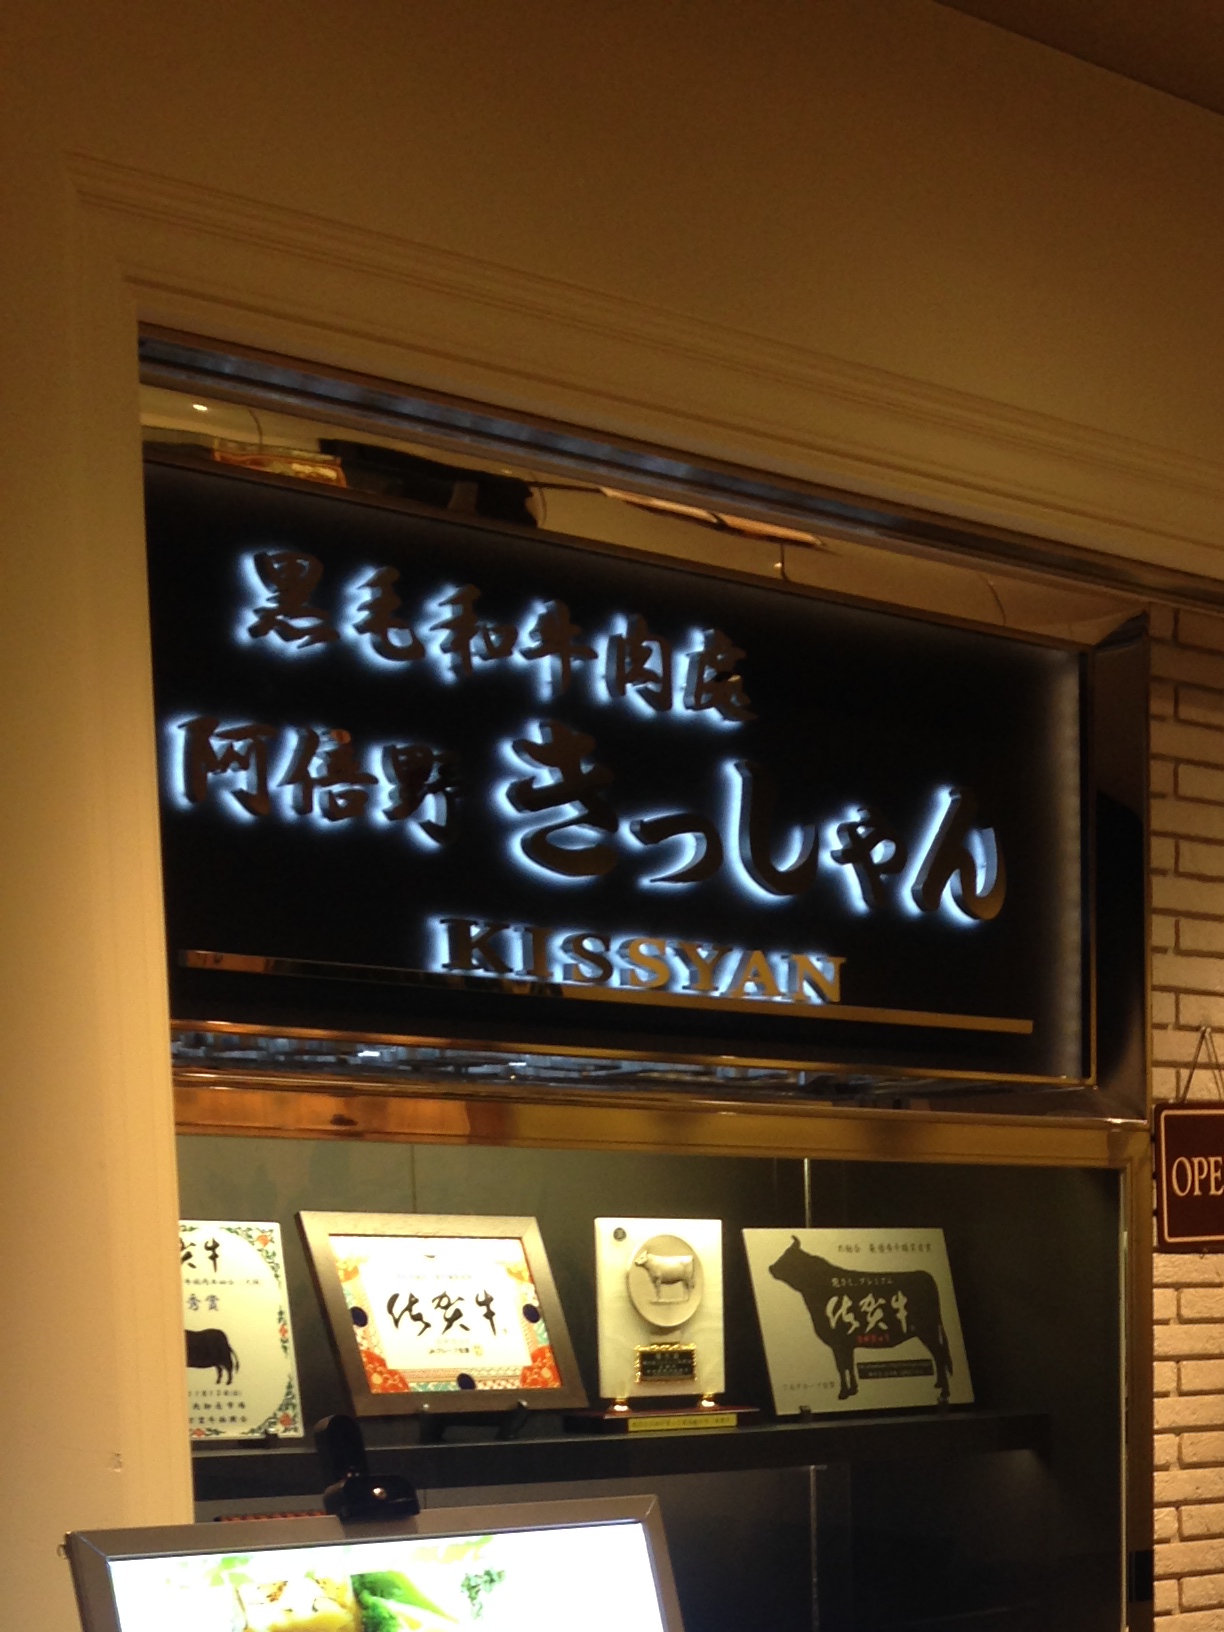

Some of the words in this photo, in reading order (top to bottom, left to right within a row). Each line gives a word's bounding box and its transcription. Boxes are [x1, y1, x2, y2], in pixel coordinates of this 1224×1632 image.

[174, 715, 461, 847] 阿倍野
[500, 719, 1006, 922] きっしゃん
[430, 917, 846, 1004] KISSYAN
[386, 1289, 497, 1337] 佐賀牛
[826, 1290, 908, 1335] 佐賀牛
